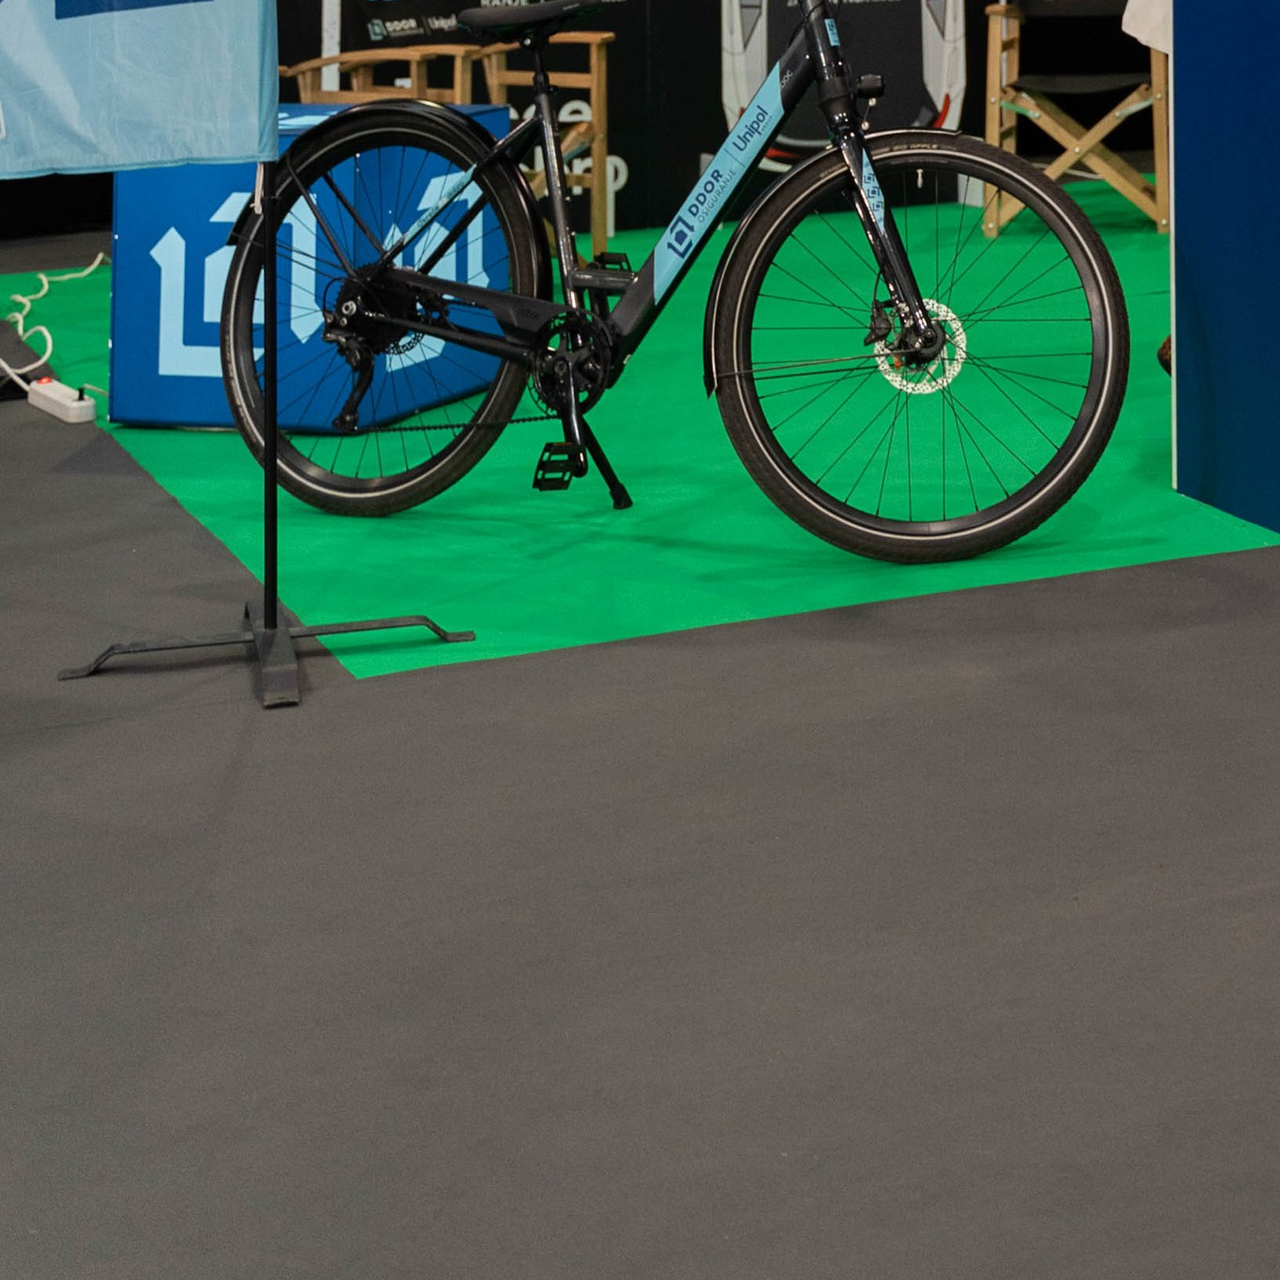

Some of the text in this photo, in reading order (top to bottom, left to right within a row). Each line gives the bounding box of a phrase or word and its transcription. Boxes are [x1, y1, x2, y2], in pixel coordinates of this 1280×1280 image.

[687, 105, 770, 219] DDOR Unipol
[697, 167, 738, 224] OSIGURANJE
